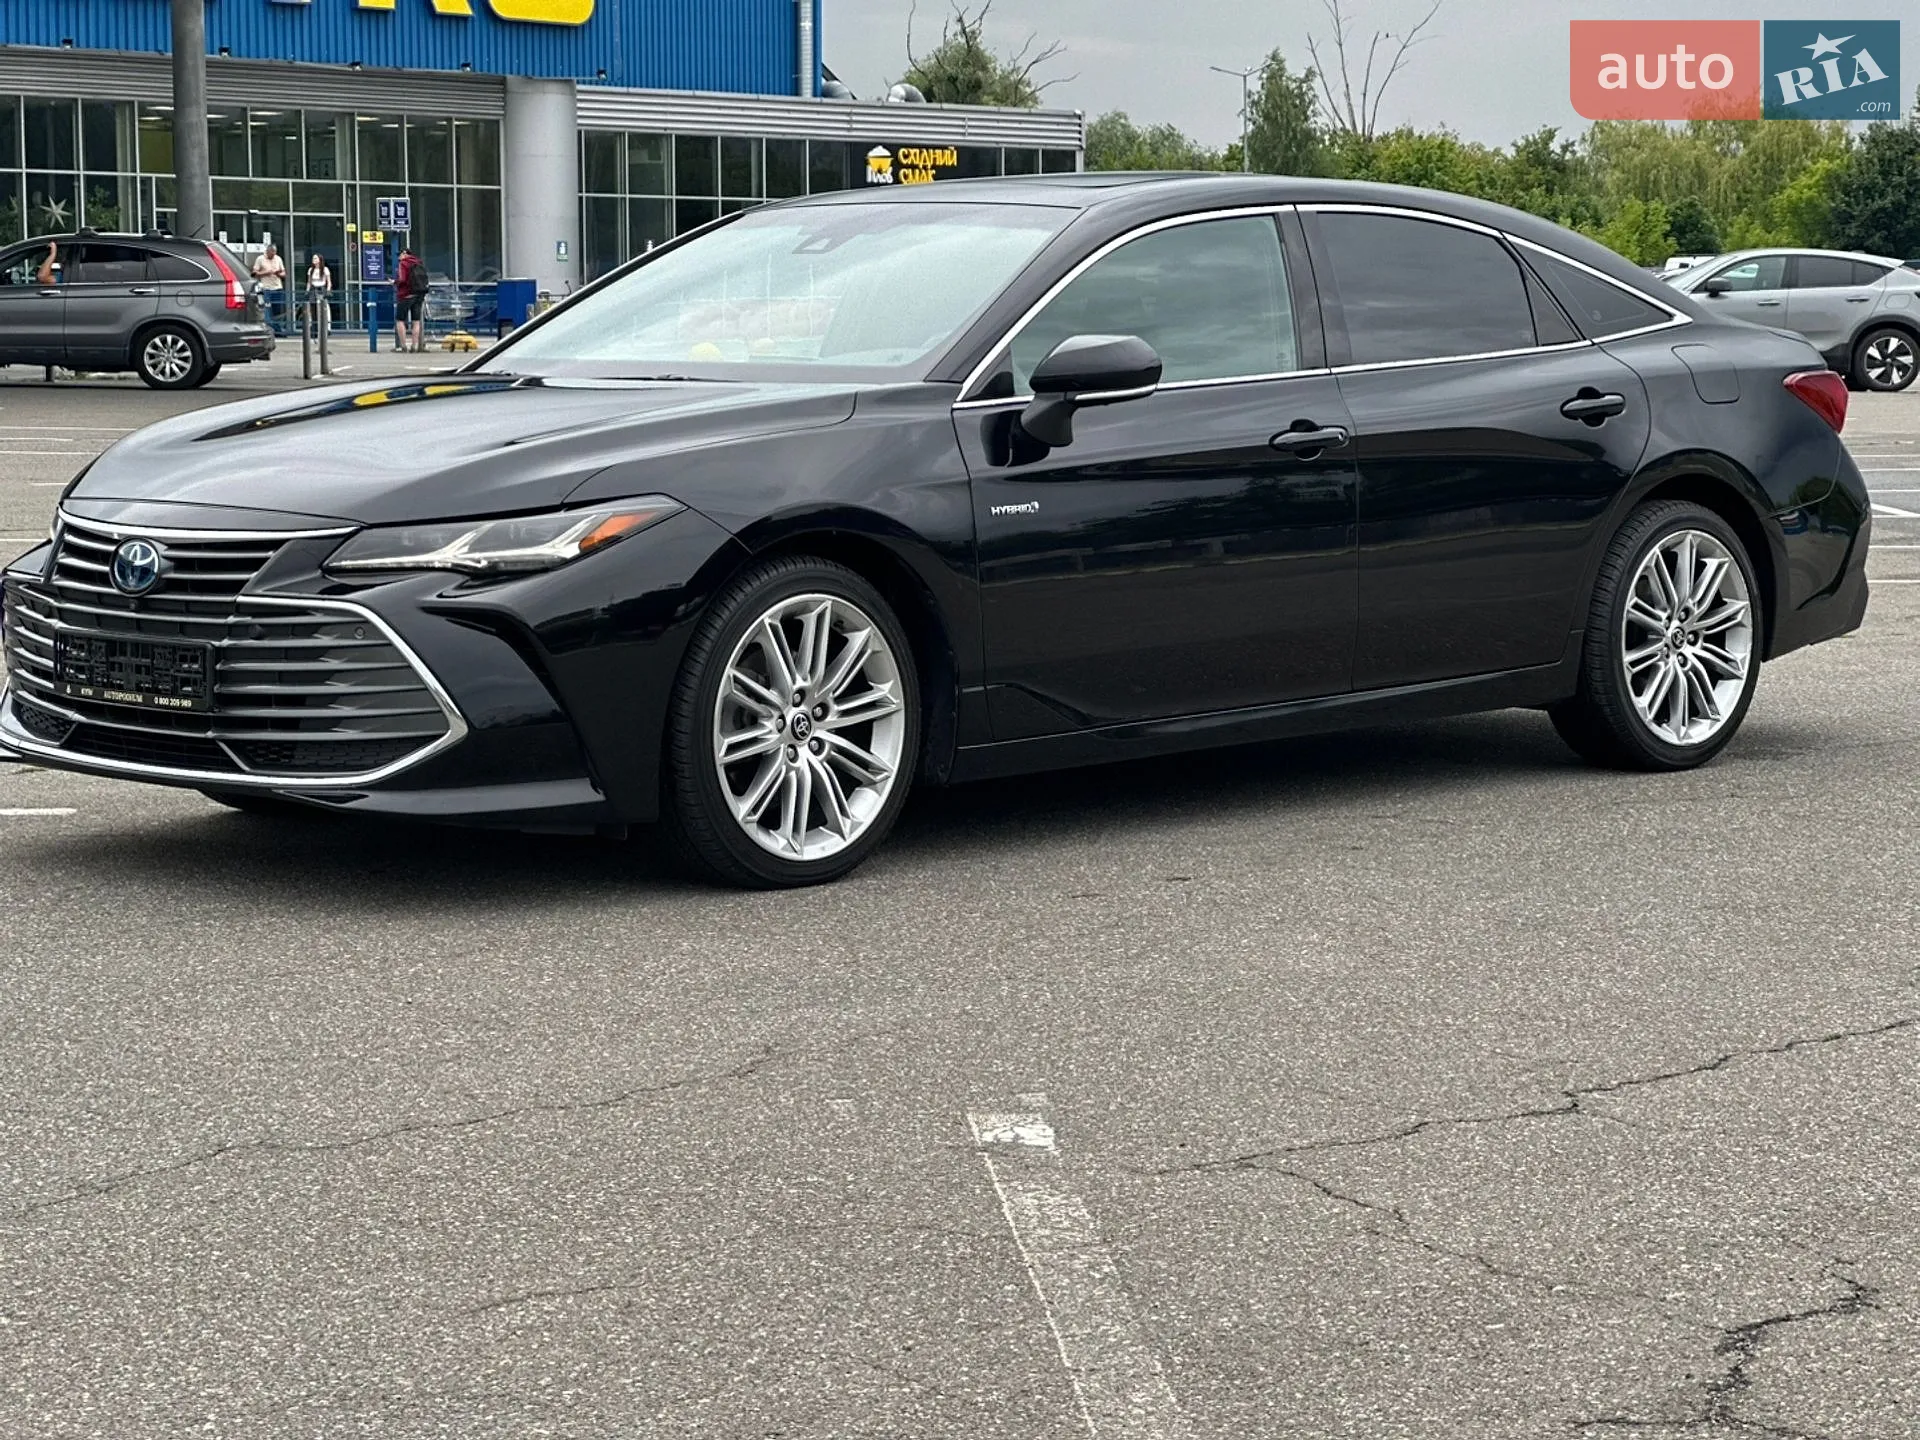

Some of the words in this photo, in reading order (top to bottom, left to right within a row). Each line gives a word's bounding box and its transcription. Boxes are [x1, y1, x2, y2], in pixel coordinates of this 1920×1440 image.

[898, 146, 958, 168] СХІДНИЙ
[899, 168, 936, 184] СМАК
[990, 503, 1032, 516] HYBRID
